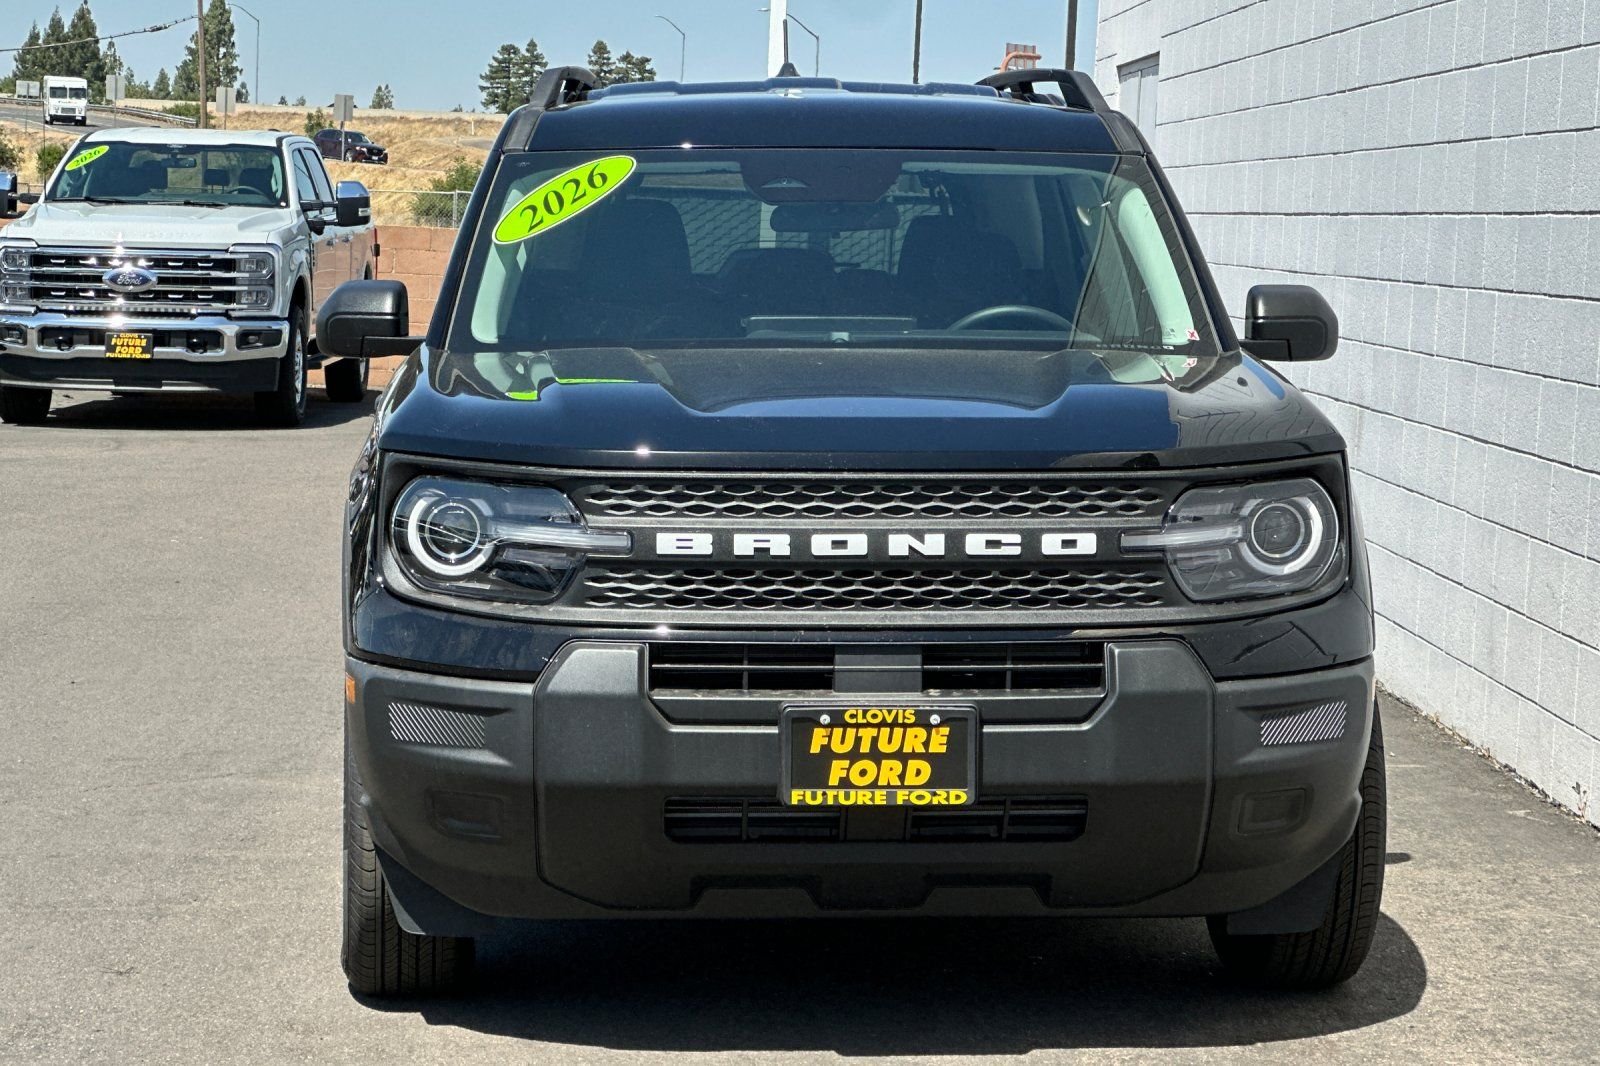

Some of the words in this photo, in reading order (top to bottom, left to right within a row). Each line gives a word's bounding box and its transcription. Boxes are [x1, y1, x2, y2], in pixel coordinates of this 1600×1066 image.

[74, 150, 100, 166] 2026
[519, 162, 608, 233] 2026
[117, 272, 142, 285] Ford
[111, 338, 147, 346] FUTURE
[115, 346, 143, 354] FORD
[655, 532, 1097, 557] BRONCO
[844, 709, 916, 724] CLOVIS
[809, 727, 950, 753] FUTURE
[828, 760, 932, 786] FORD
[791, 790, 887, 805] FUTURE
[896, 790, 968, 805] FORD
